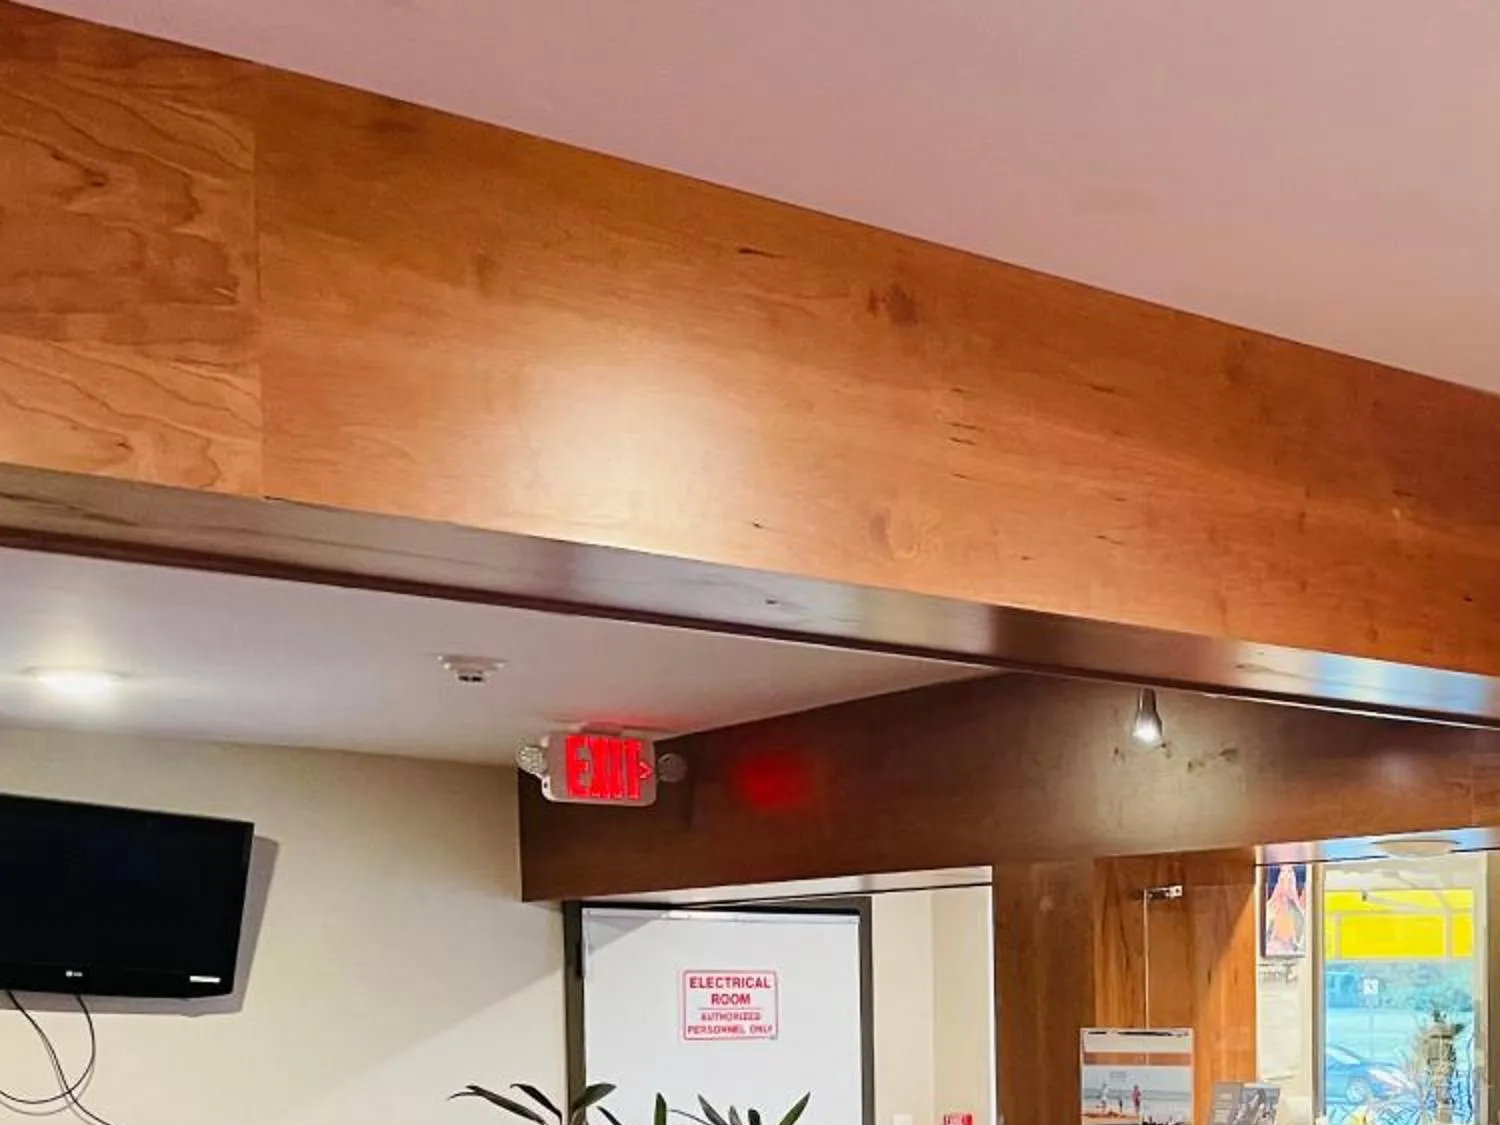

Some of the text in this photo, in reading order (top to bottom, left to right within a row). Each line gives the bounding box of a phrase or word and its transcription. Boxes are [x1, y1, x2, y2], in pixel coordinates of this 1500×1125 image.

[566, 735, 642, 801] EXIT
[689, 976, 771, 989] ELECTRICAL
[711, 993, 751, 1005] ROOM
[701, 1012, 761, 1021] AUTHORIZED
[688, 1025, 746, 1034] PERSONNEL
